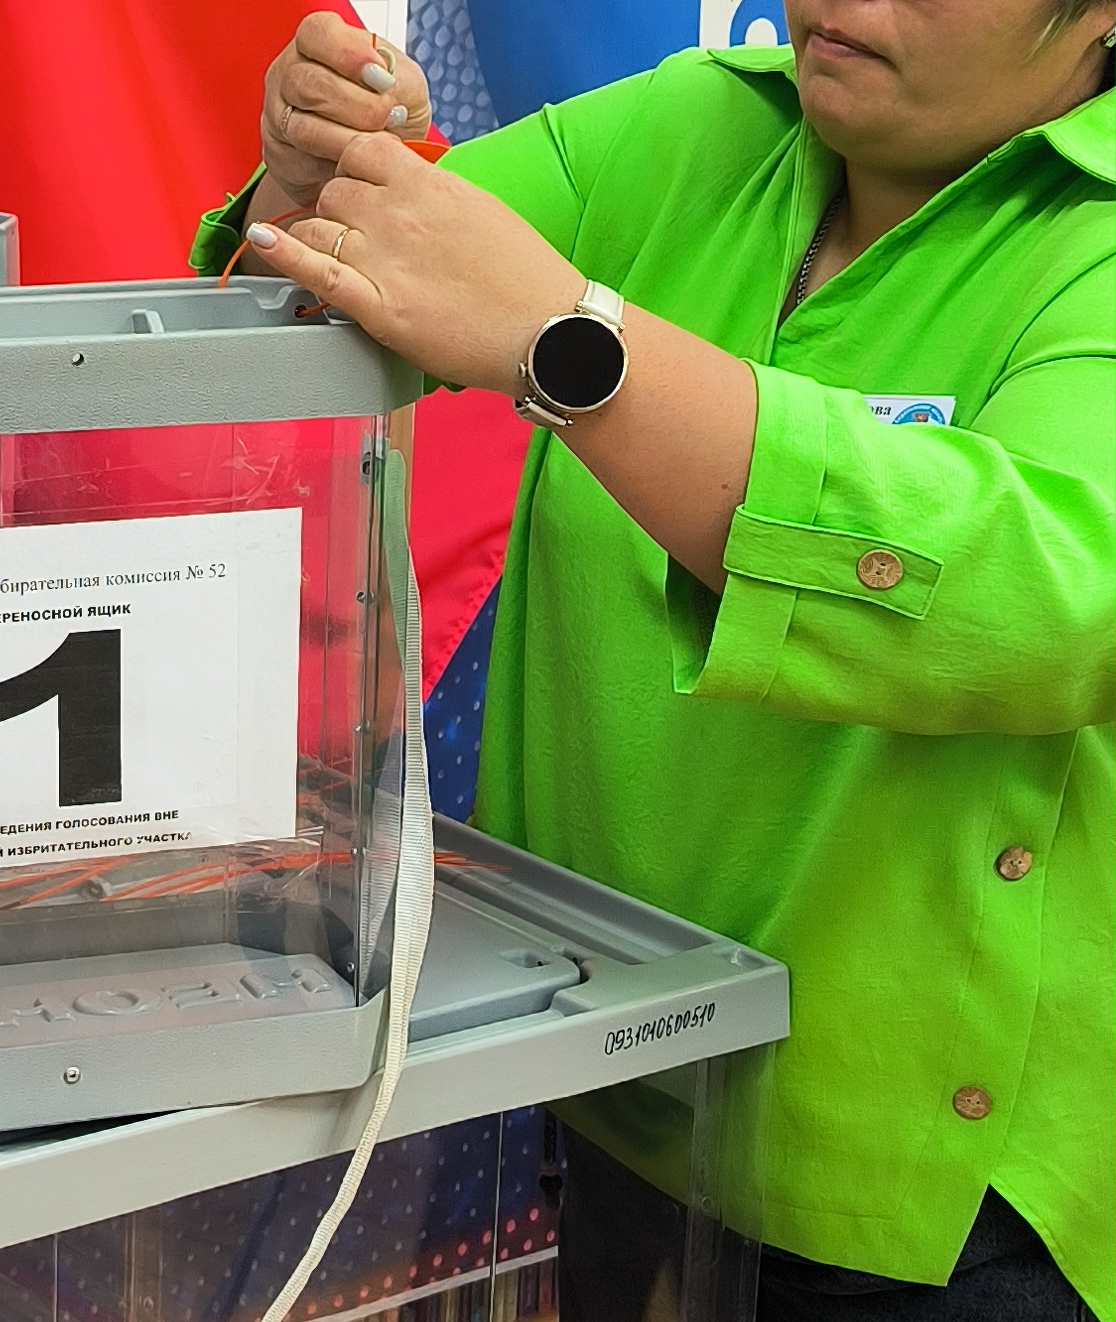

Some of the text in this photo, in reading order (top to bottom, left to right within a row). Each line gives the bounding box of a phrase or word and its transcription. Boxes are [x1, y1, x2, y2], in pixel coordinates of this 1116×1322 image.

[106, 569, 181, 587] комиссия
[185, 565, 204, 581] №
[208, 563, 227, 579] 52
[87, 603, 132, 619] ЯЩИК
[55, 812, 151, 830] ГОЛОСОВАНИЯ
[154, 809, 180, 821] ВНЕ
[7, 836, 133, 857] ИЗБРИТАТЕЛЬНОГО
[604, 1002, 716, 1056] 0931010600510
